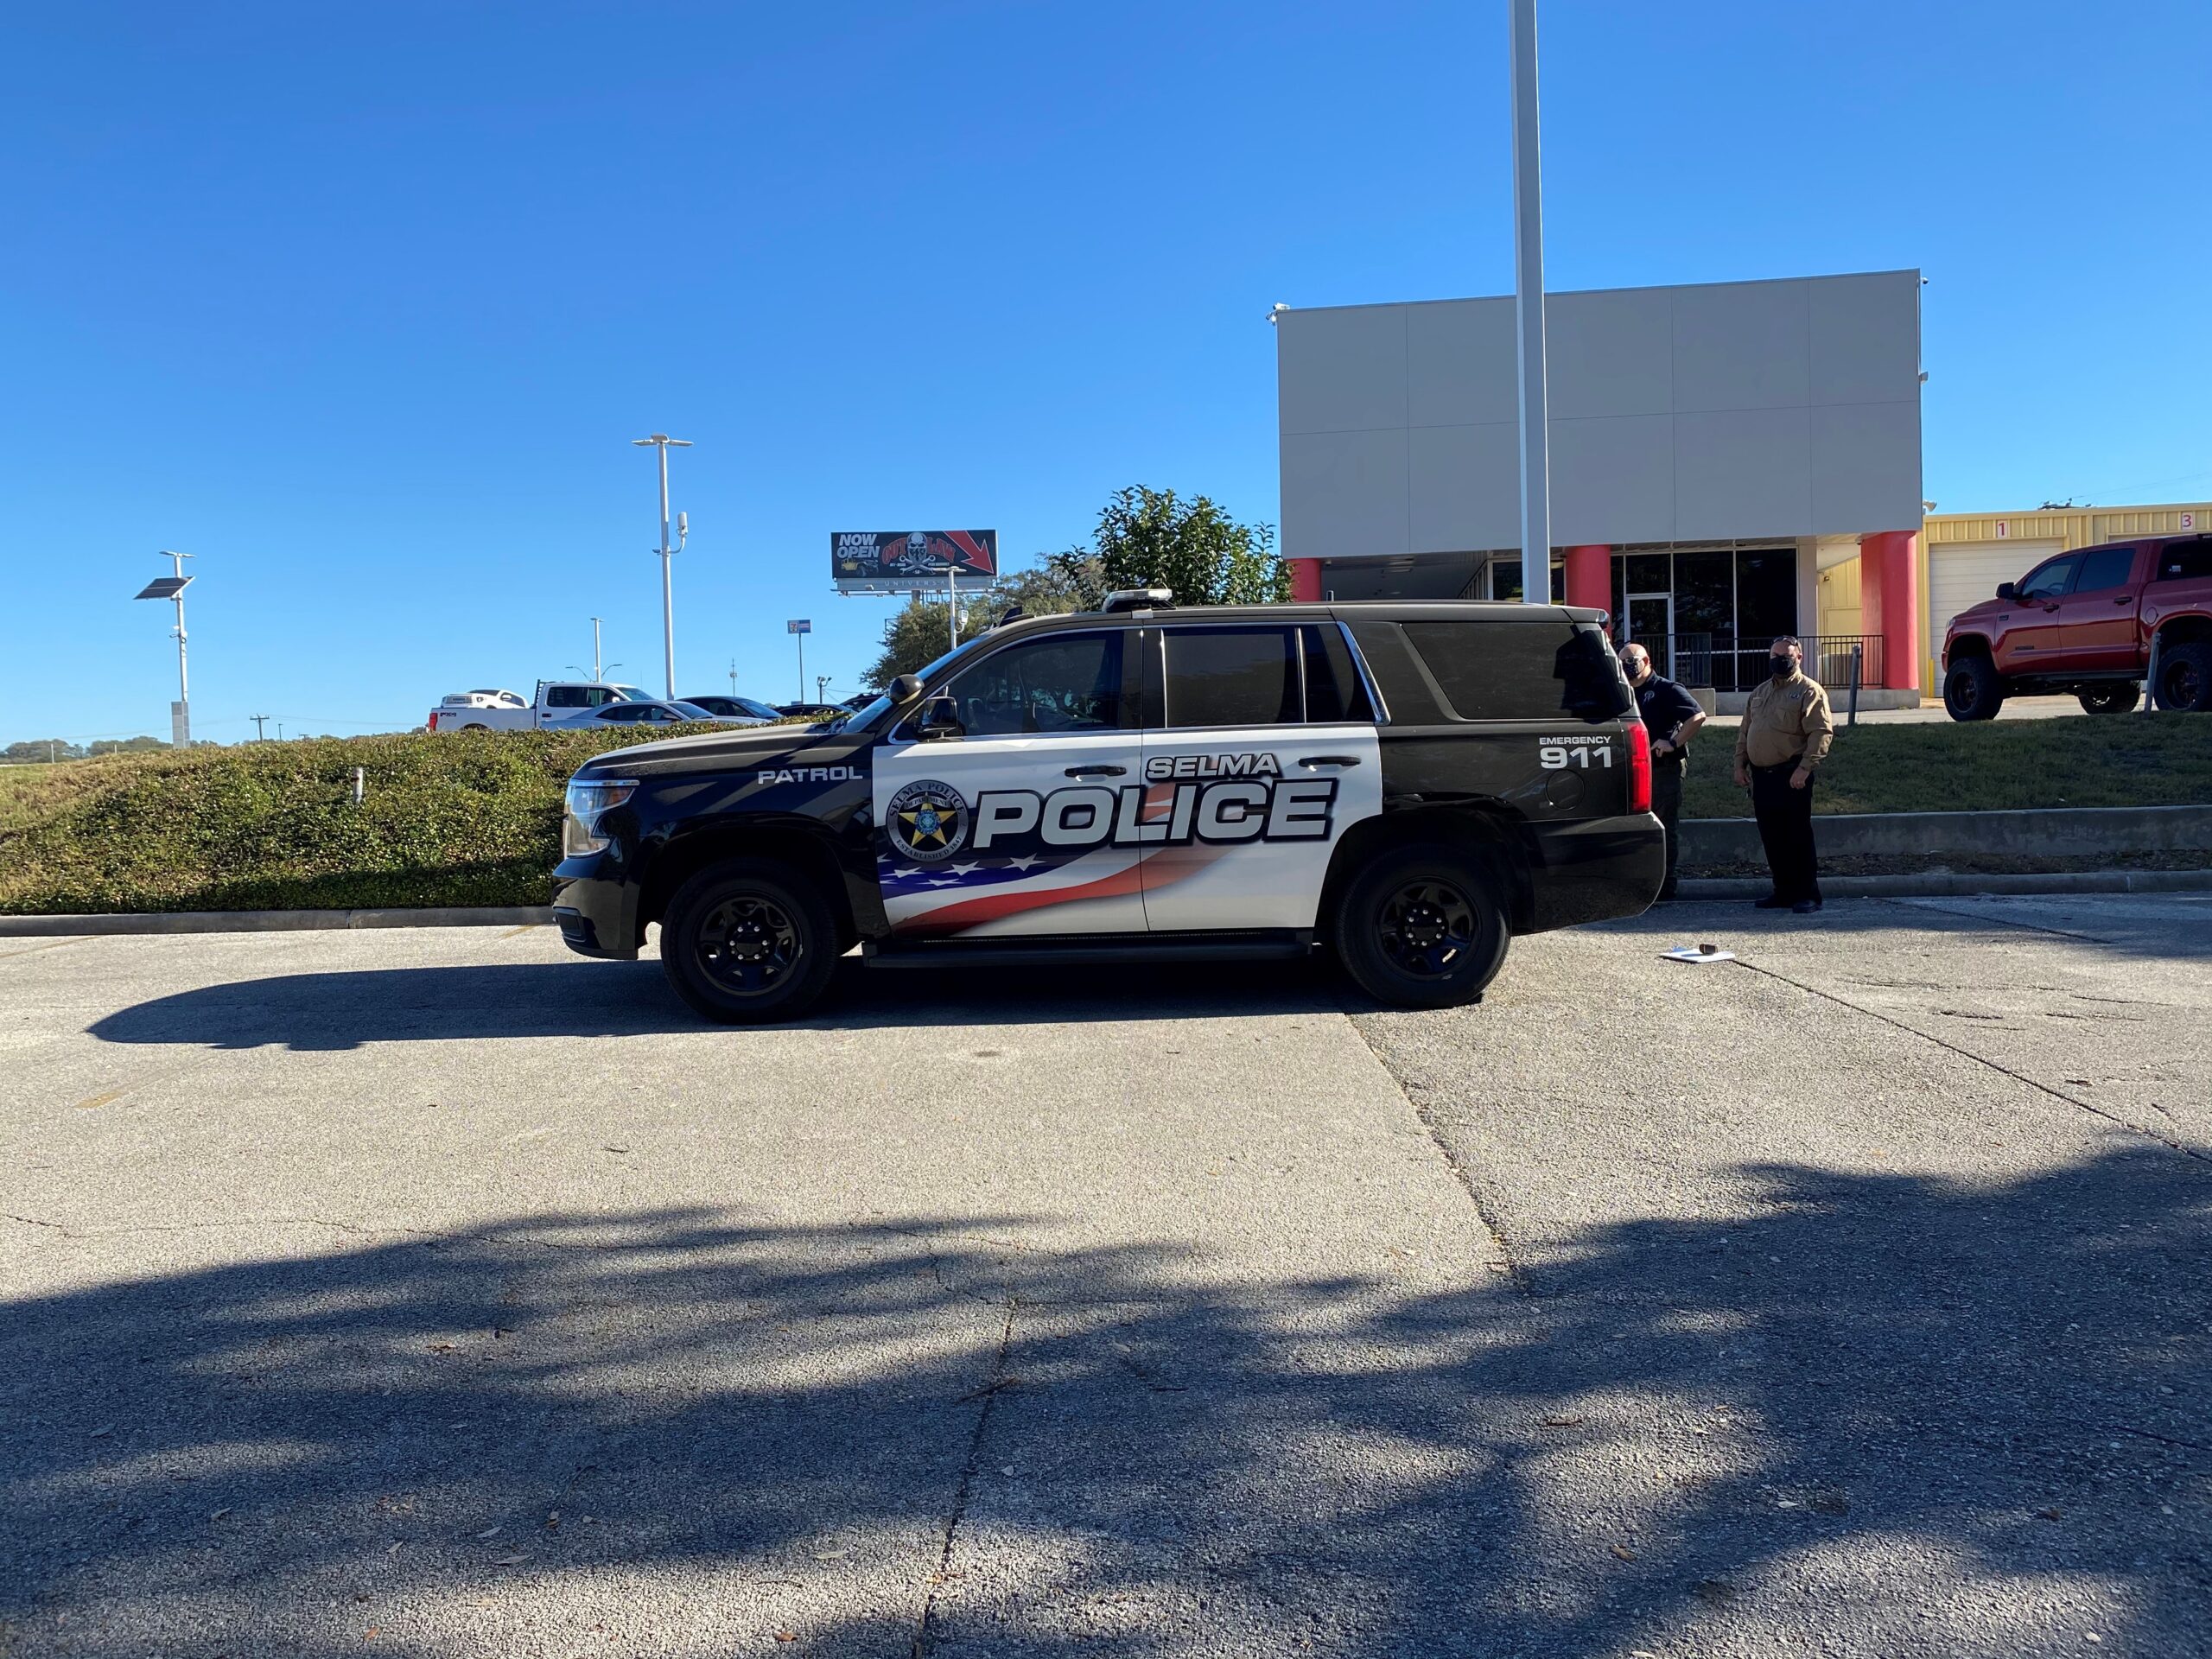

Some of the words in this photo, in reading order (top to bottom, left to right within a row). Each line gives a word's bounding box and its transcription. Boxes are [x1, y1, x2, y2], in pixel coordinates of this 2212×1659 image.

[1998, 522, 2005, 537] 1
[2182, 514, 2192, 528] 3
[839, 534, 877, 546] NOW
[837, 546, 880, 558] OPEN
[1539, 736, 1611, 745] EMERGENCY
[1146, 753, 1281, 779] SELMA
[1540, 747, 1611, 769] 911
[758, 766, 863, 785] PATROL
[889, 784, 923, 817] SELMA
[927, 782, 966, 815] POLICE
[971, 779, 1336, 849] POLICE
[895, 838, 950, 860] ESTABLISHED
[950, 836, 962, 851] 1847
